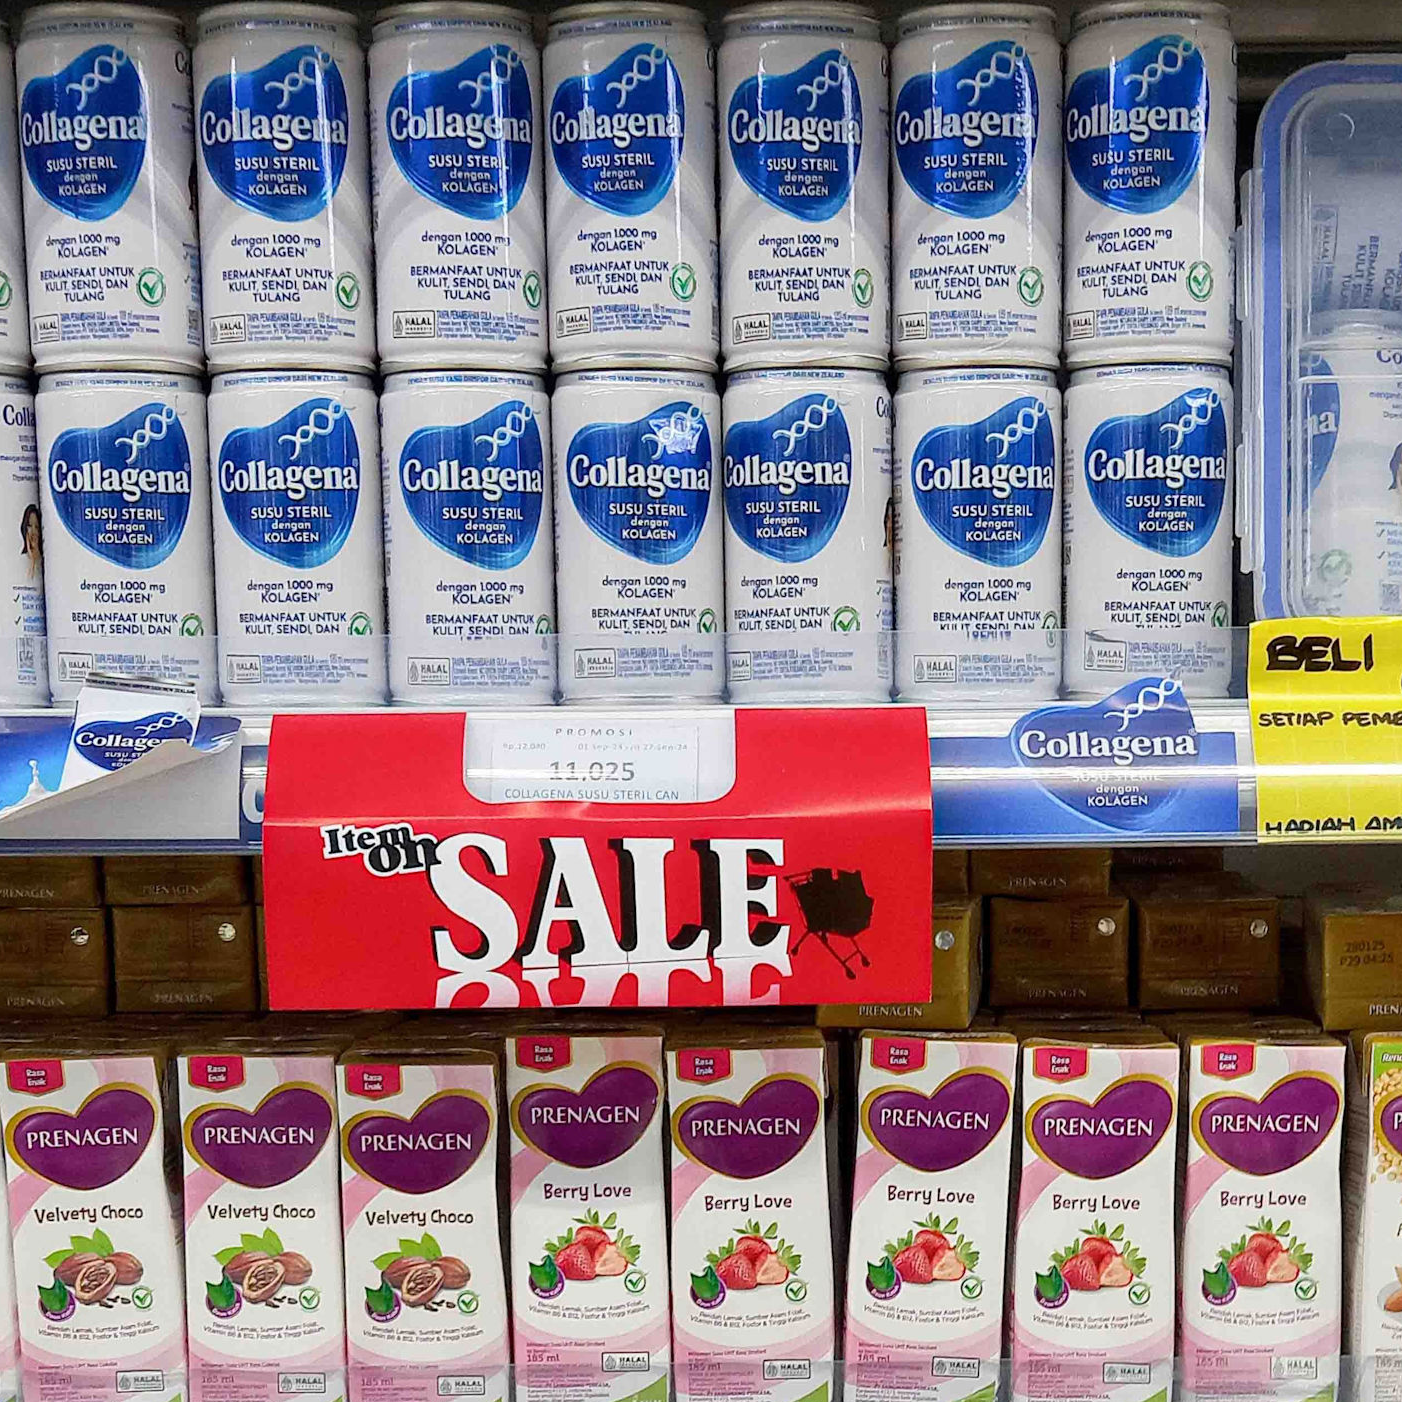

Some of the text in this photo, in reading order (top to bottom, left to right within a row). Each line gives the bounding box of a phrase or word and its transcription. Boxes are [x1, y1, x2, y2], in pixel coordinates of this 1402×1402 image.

[201, 111, 348, 151] Collagena
[731, 109, 860, 150] Collagena
[1266, 634, 1374, 674] BELI
[1258, 711, 1335, 728] SETIAP
[505, 789, 680, 801] COLLAGENA SUSU STERIL CAN
[324, 825, 413, 858] Item
[369, 833, 442, 874] on
[434, 832, 793, 972] SALE
[530, 1106, 640, 1125] PRENAGEN
[887, 1184, 975, 1206] Berry Love
[207, 1204, 317, 1223] Velvety Choco
